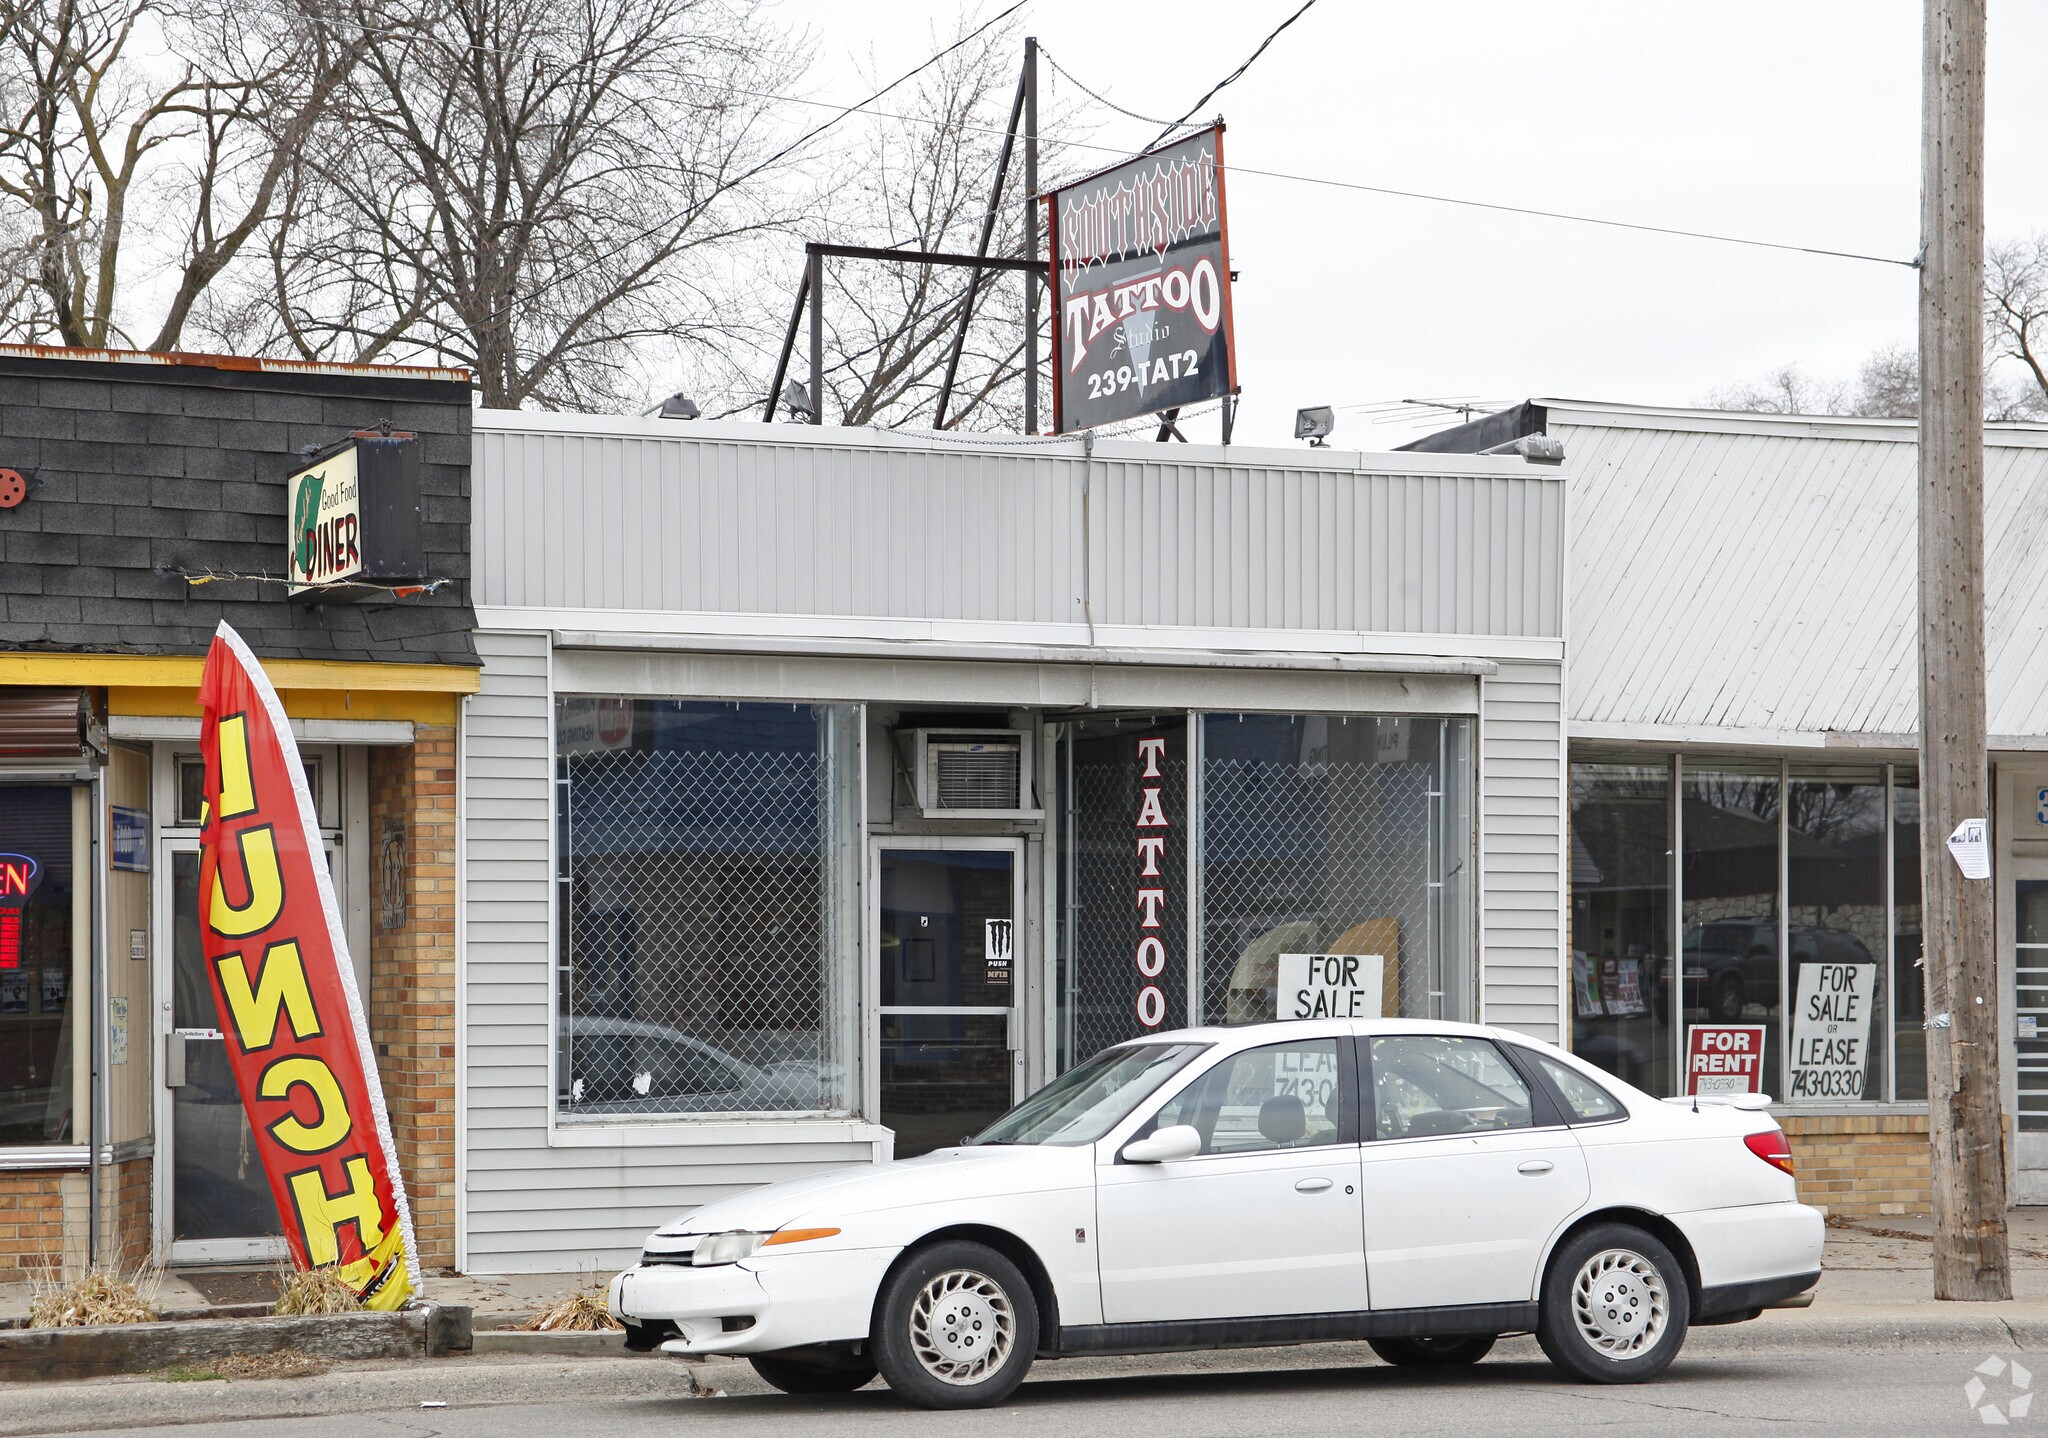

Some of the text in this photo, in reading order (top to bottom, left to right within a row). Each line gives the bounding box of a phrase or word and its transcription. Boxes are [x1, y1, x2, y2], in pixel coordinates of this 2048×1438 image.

[1063, 148, 1217, 293] SOUTHSIDE
[1066, 256, 1221, 375] TATTOO
[1110, 321, 1171, 360] Studio
[1087, 350, 1200, 400] 239-TAT2
[322, 485, 338, 511] Good
[340, 476, 357, 504] Food
[305, 513, 359, 582] DINER
[1136, 738, 1169, 1027] TATTOO
[1308, 956, 1359, 987] FOR
[1819, 965, 1858, 992] FOR
[1294, 989, 1365, 1019] SALE
[1808, 994, 1860, 1022] SALE
[1701, 1032, 1751, 1052] FOR
[1827, 1024, 1838, 1034] OR
[1282, 1053, 1337, 1073] LEA
[1692, 1053, 1758, 1073] RENT
[1799, 1038, 1859, 1065] LEASE
[1276, 1078, 1337, 1107] 743-0
[1790, 1069, 1863, 1097] 743-0330
